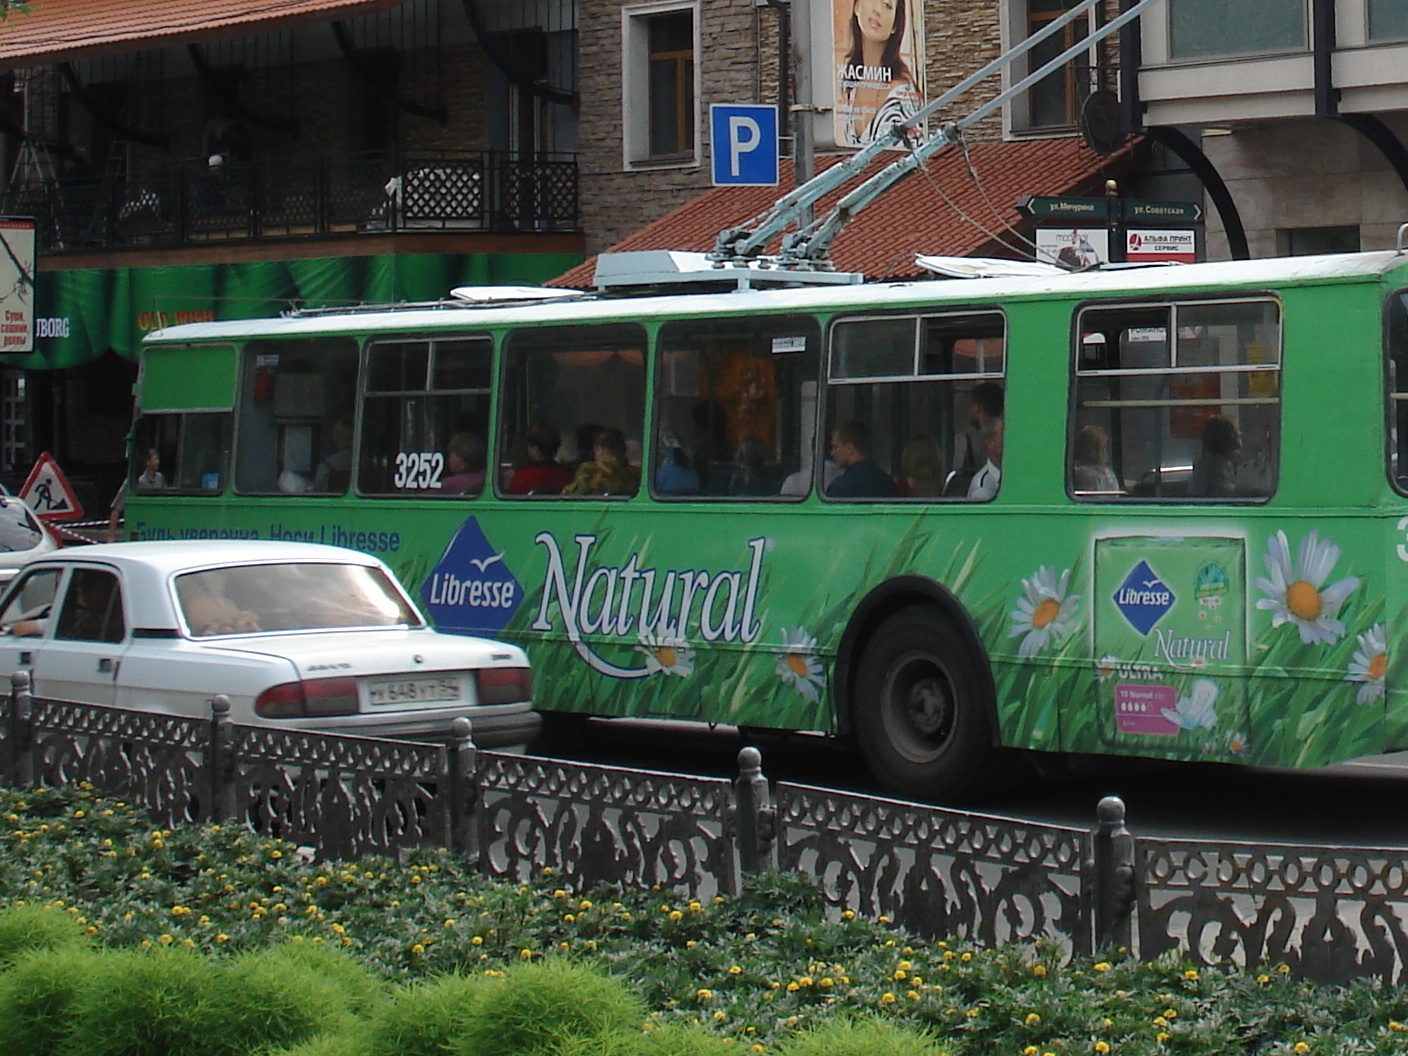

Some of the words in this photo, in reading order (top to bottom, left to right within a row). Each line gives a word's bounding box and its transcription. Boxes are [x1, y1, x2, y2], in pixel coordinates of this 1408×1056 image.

[837, 64, 892, 82] ЖАСМИН
[730, 116, 761, 177] P
[1144, 235, 1168, 243] АЛЬФА
[1170, 235, 1192, 244] ПРИНТ
[1154, 244, 1180, 252] СЕРВИС
[36, 317, 70, 339] BORG
[138, 311, 168, 331] OLD
[394, 452, 443, 490] 3252
[429, 574, 515, 608] Libresse
[1119, 589, 1169, 605] Libresse
[532, 532, 767, 679] Natural
[1154, 628, 1230, 670] Natural
[1117, 663, 1163, 680] ULTRA
